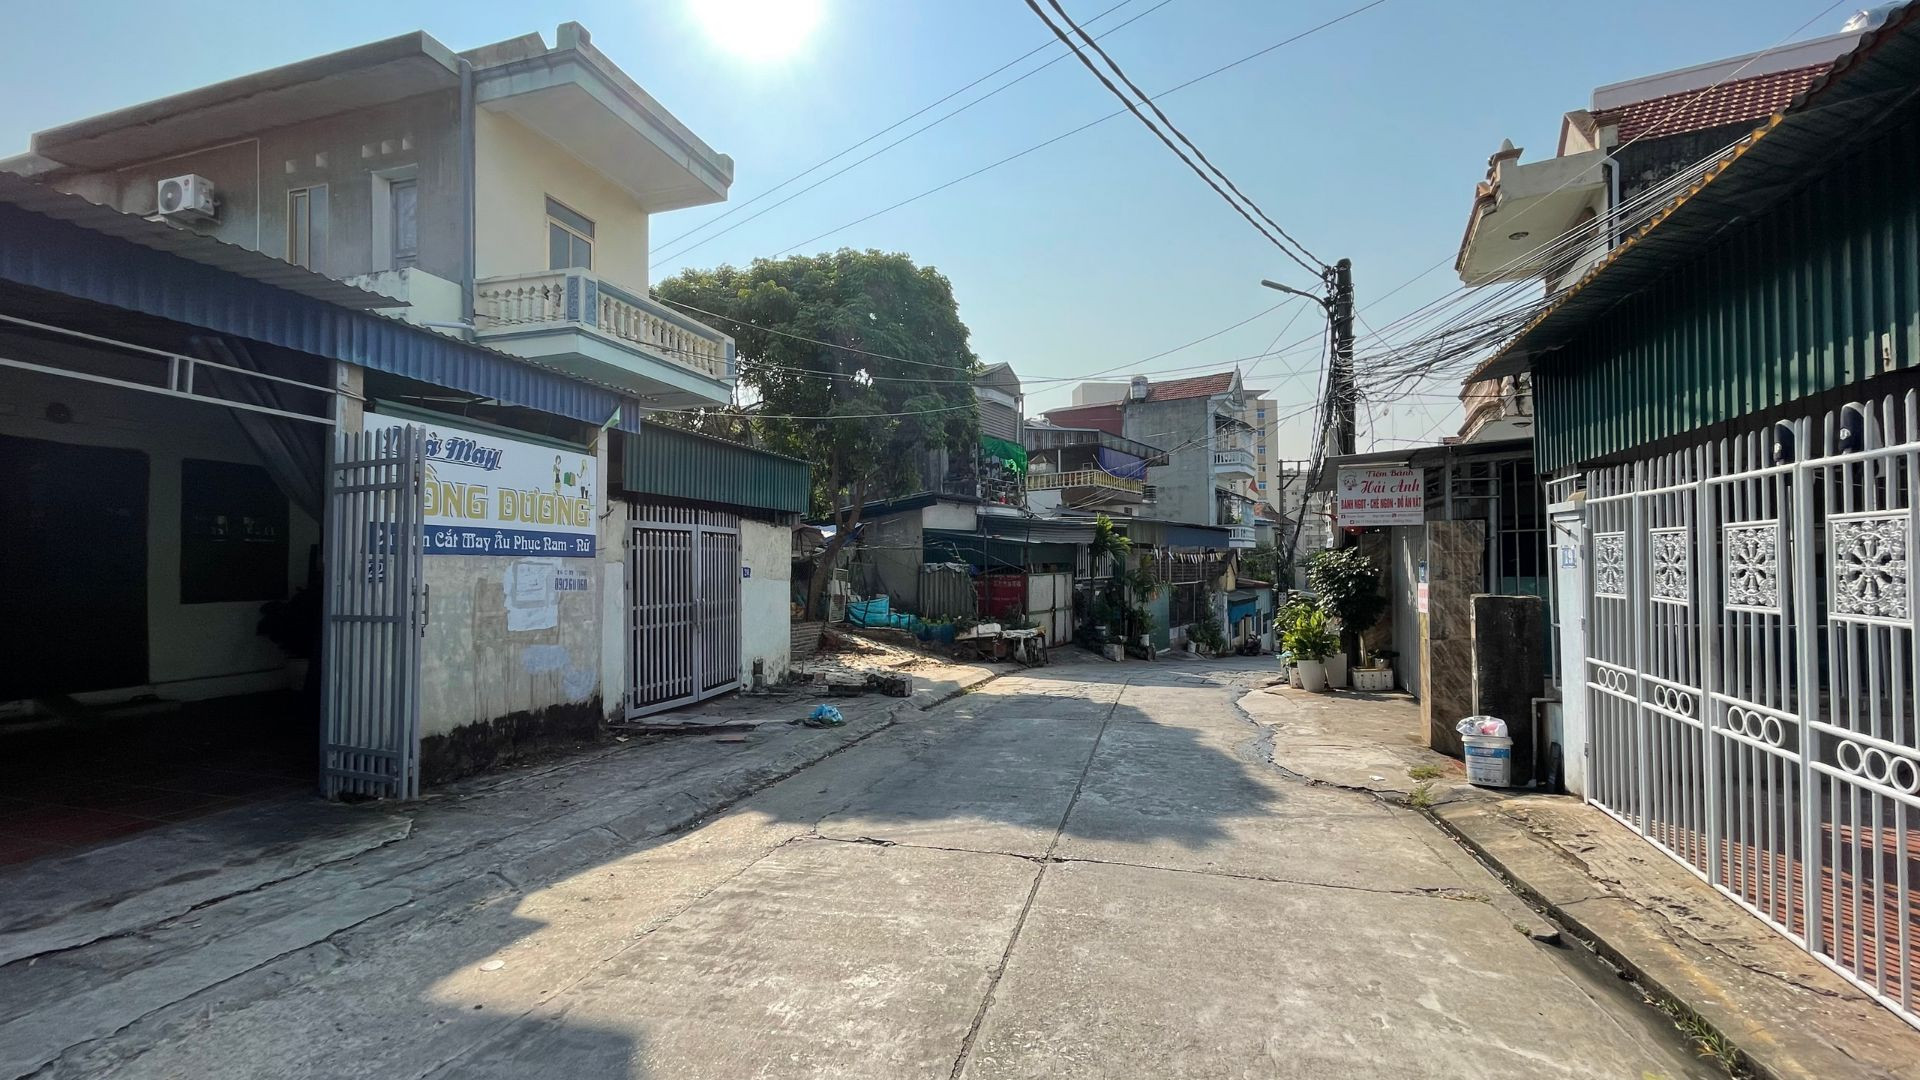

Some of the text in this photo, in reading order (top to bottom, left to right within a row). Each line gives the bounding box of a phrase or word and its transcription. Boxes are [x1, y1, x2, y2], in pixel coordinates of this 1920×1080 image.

[445, 437, 502, 470] May
[1390, 478, 1420, 493] Anh
[497, 486, 591, 528] DƯƠNG
[435, 528, 457, 548] Cắt
[462, 533, 491, 552] May
[494, 531, 511, 550] Âu
[514, 535, 541, 554] Phục
[544, 537, 567, 552] Nam
[576, 537, 591, 553] Nữ
